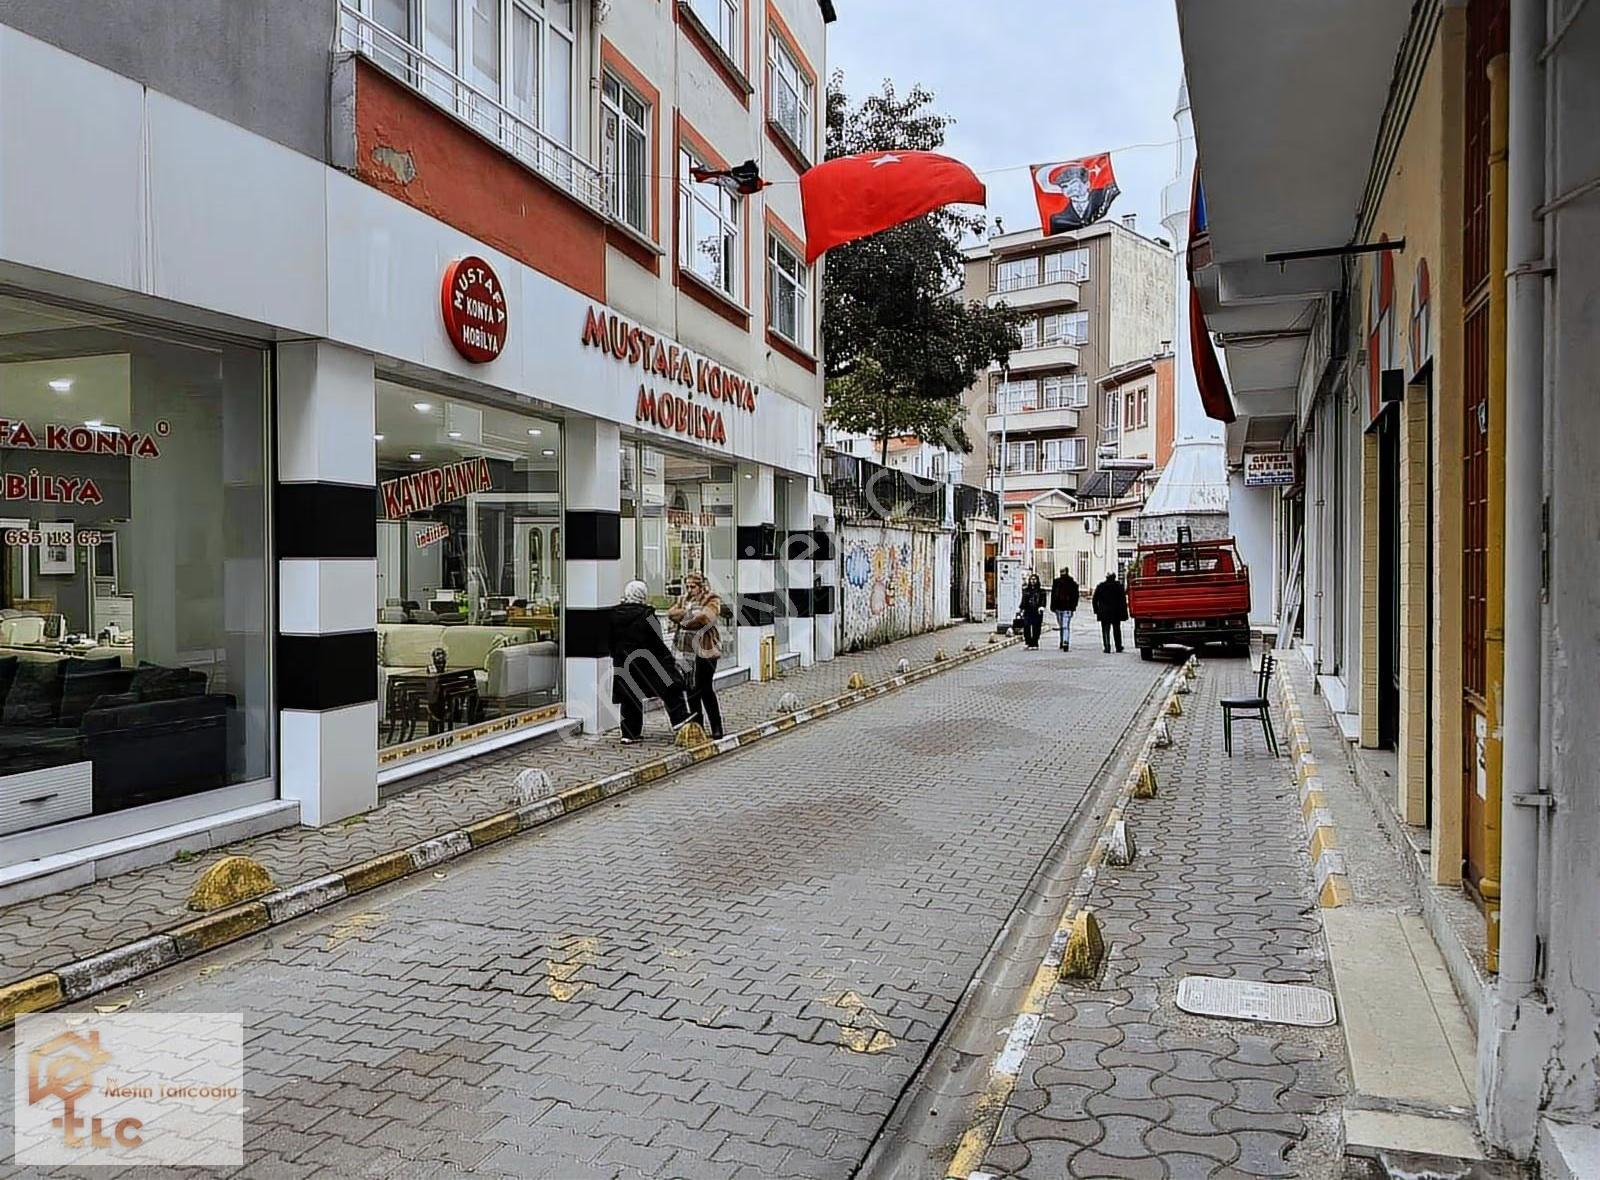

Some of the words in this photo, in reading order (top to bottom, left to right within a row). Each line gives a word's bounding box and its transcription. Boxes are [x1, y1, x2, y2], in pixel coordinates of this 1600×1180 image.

[454, 267, 505, 323] MUSTAFA
[466, 296, 495, 324] KONYA
[463, 324, 499, 354] MOBİLYA
[582, 305, 694, 389] MUSTAFA
[697, 358, 756, 414] KONYA
[636, 383, 726, 446] MOBİLYA
[45, 423, 160, 459] KONYA
[0, 468, 103, 505] BİLYA
[380, 456, 493, 520] KAMPANYA
[5, 529, 42, 545] 685
[78, 530, 102, 545] 65
